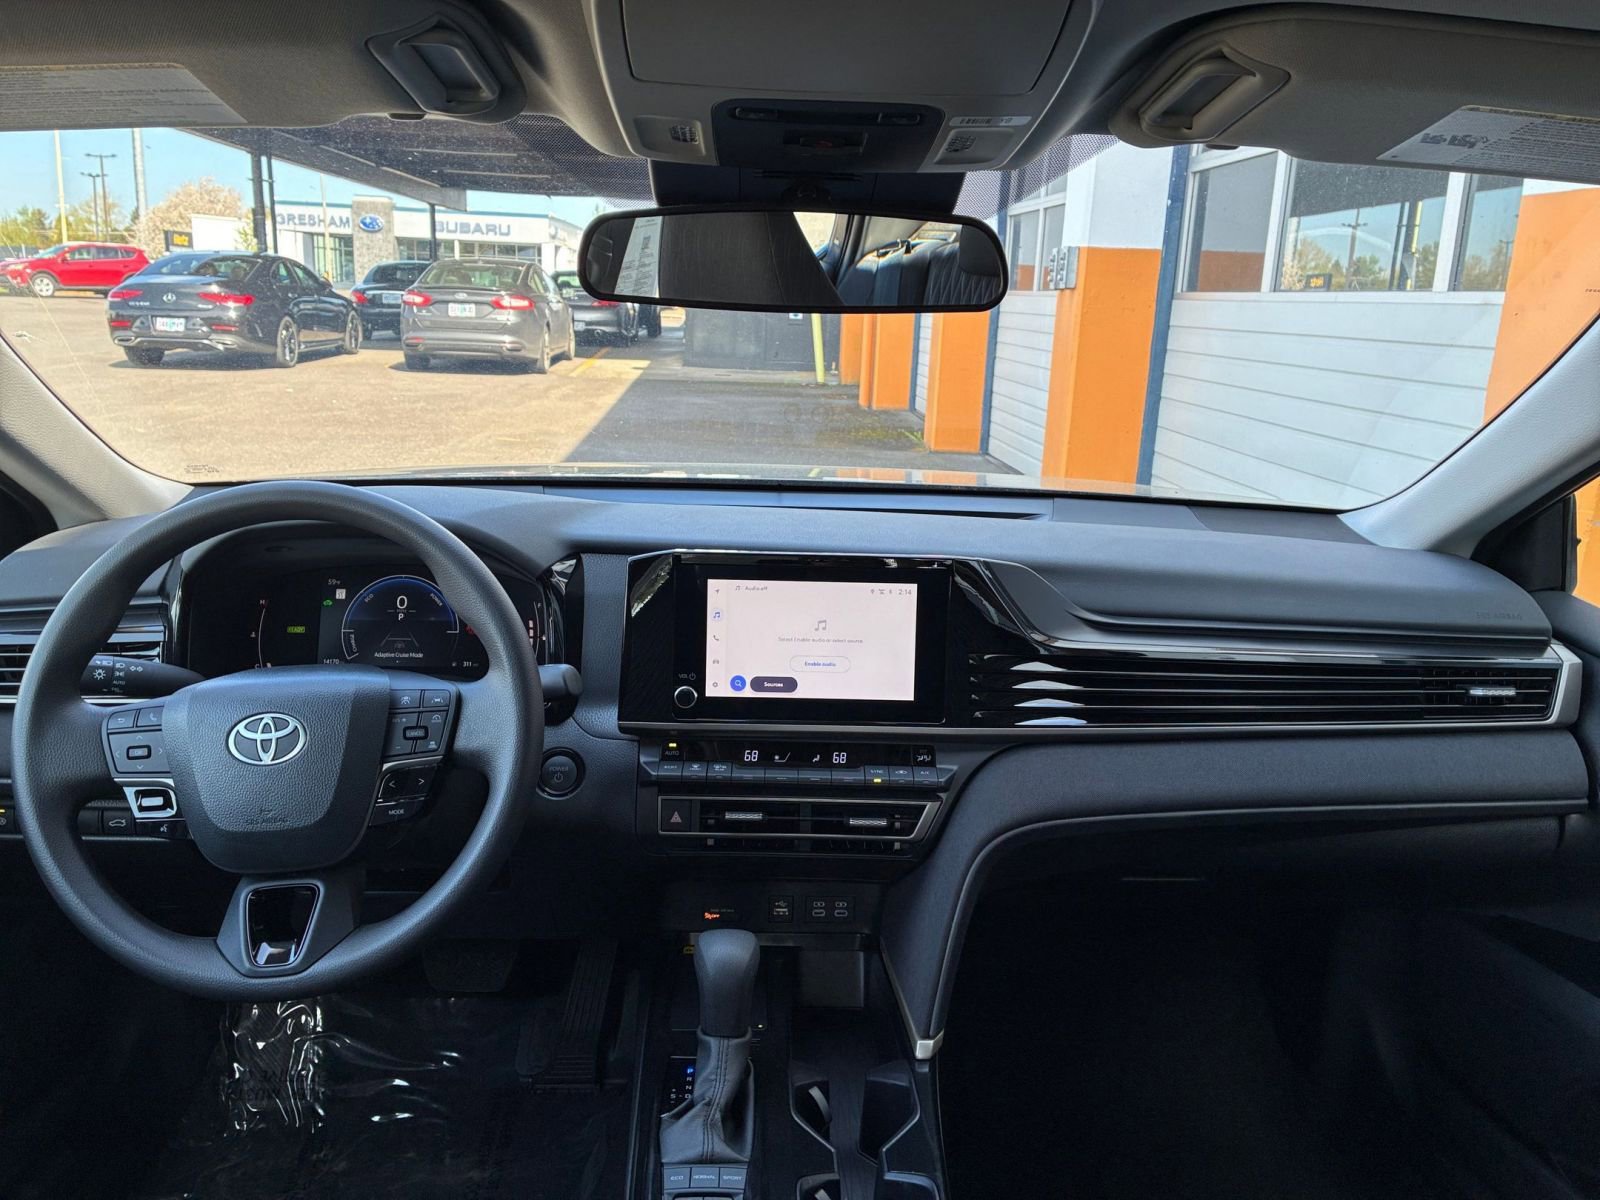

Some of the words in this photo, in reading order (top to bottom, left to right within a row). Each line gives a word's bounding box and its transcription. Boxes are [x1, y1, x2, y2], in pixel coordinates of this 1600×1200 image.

[435, 220, 511, 237] SUBARU
[898, 588, 912, 596] 2:14
[396, 595, 408, 609] 0
[397, 613, 405, 621] P
[744, 750, 759, 762] 68
[832, 752, 847, 764] 68
